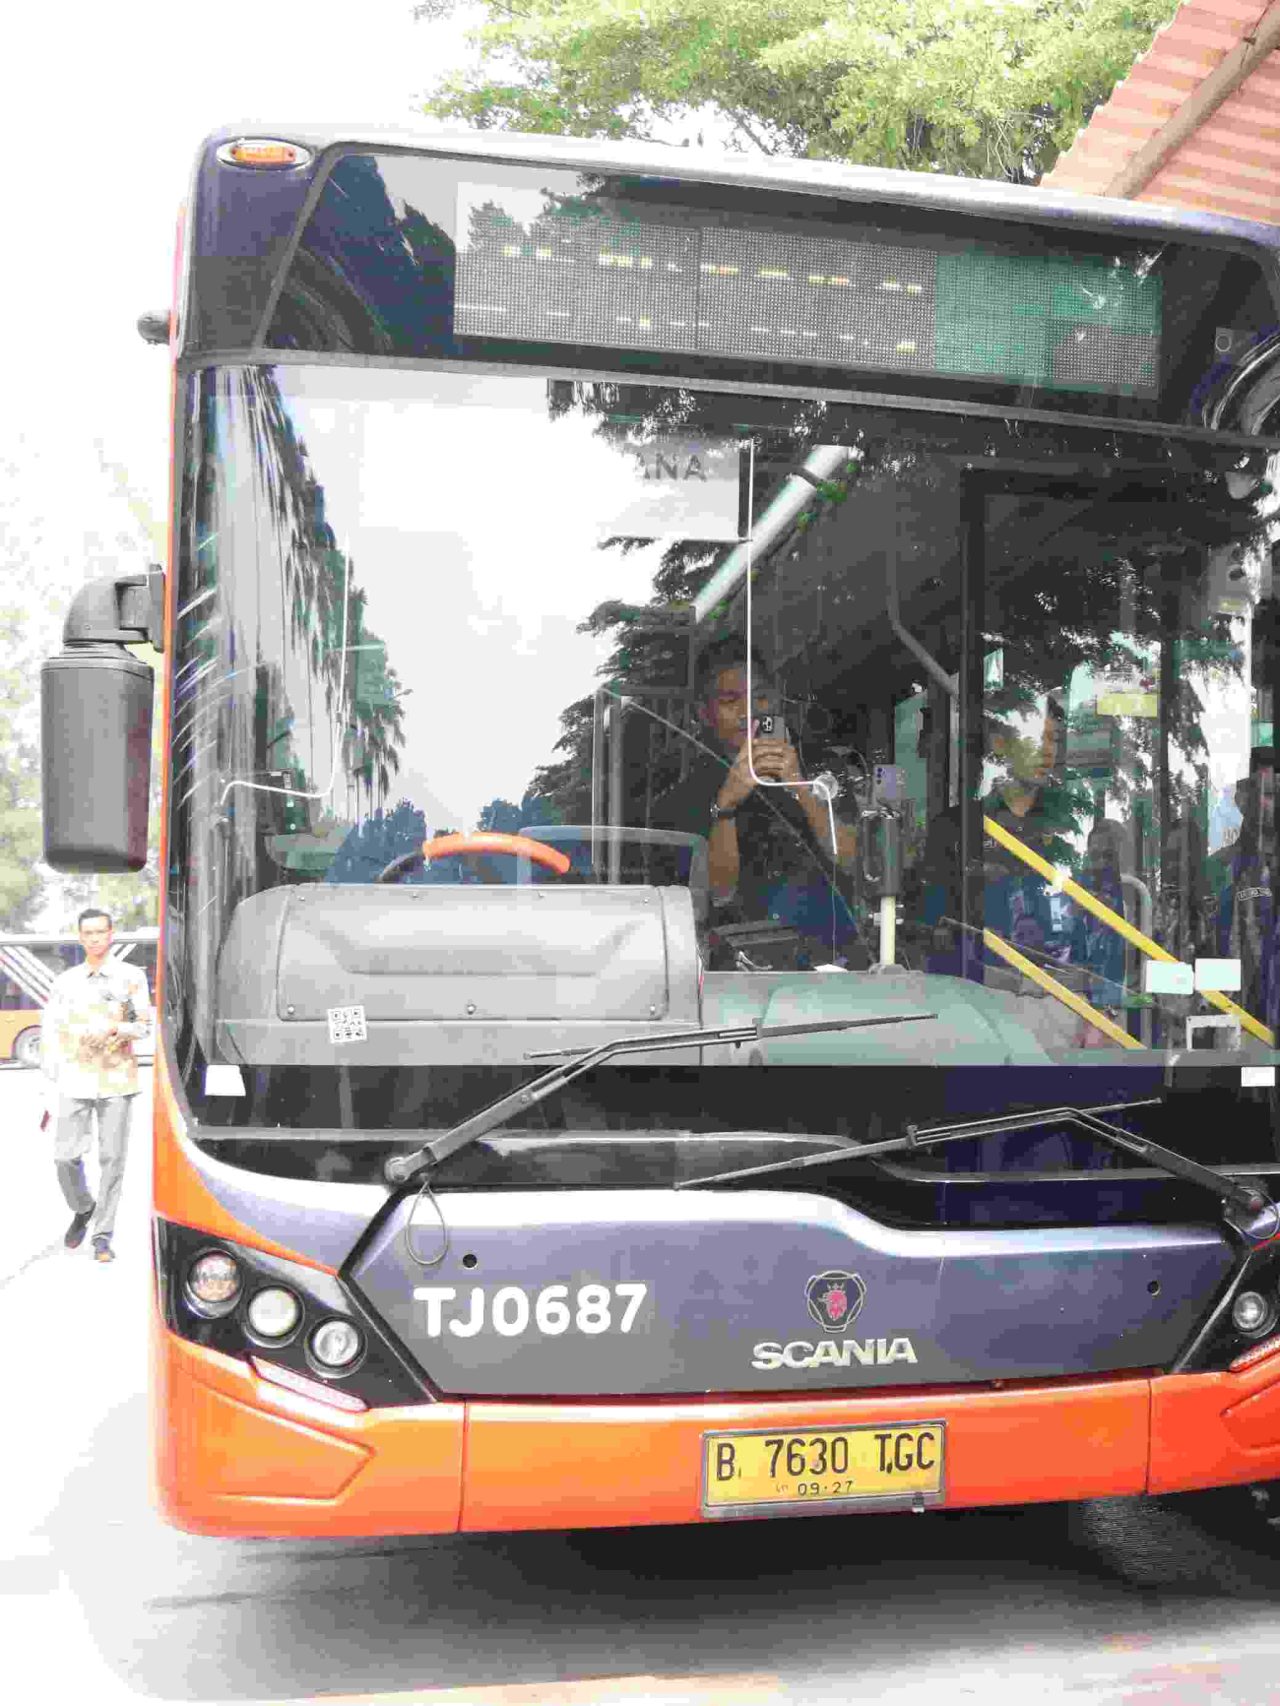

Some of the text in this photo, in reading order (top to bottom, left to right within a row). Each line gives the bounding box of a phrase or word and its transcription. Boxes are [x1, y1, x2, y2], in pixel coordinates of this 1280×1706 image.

[413, 1284, 647, 1337] TJ0687
[751, 1337, 918, 1370] SCANIA
[716, 1432, 935, 1481] B 7630 TGC
